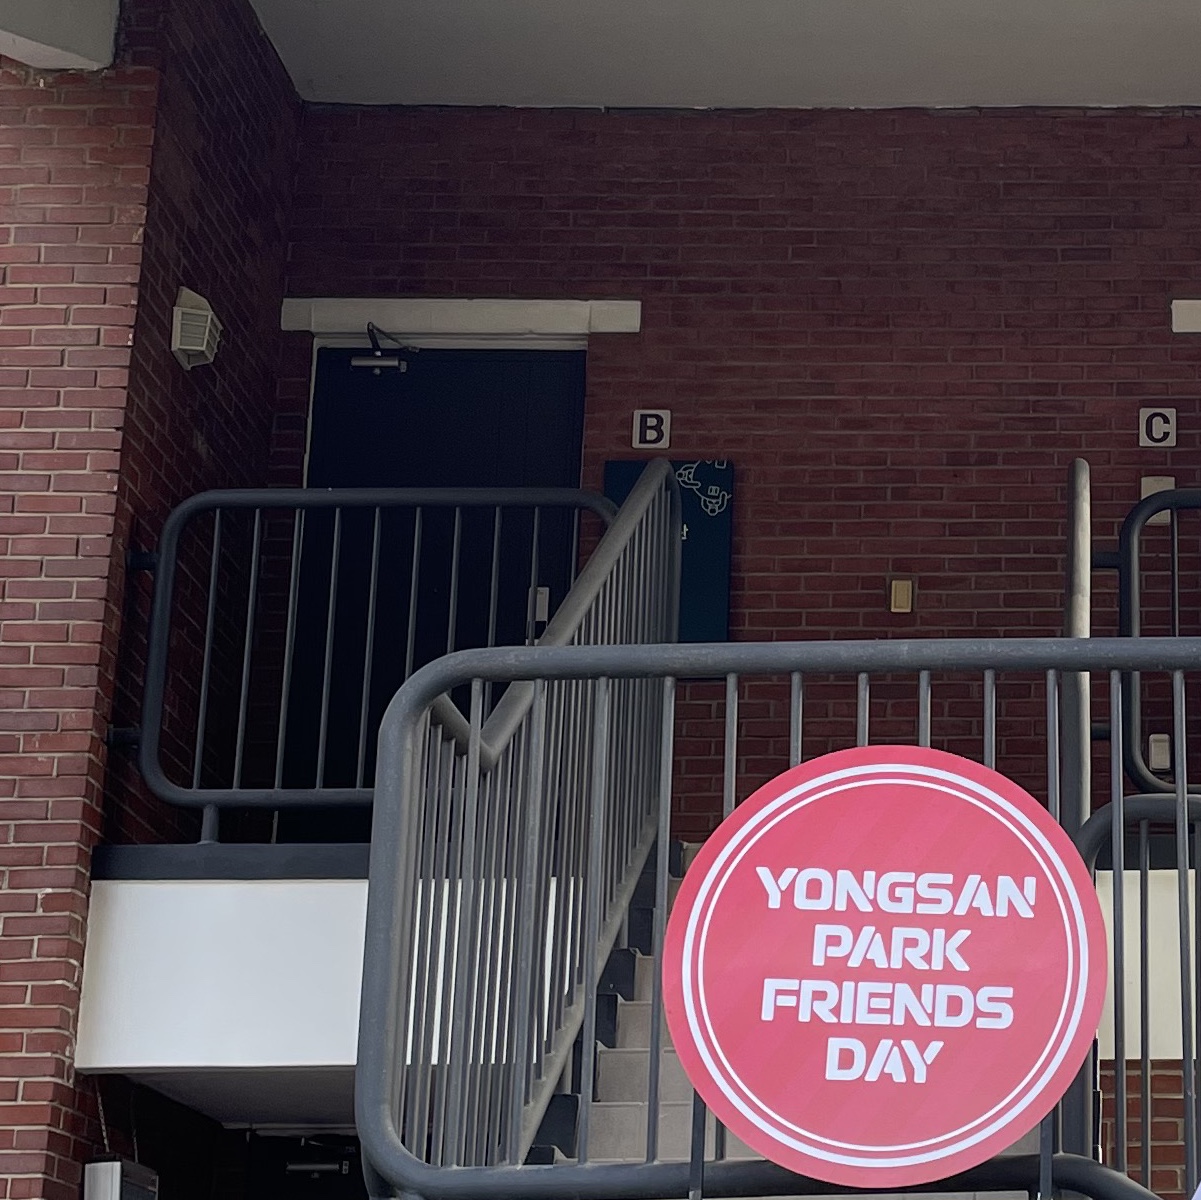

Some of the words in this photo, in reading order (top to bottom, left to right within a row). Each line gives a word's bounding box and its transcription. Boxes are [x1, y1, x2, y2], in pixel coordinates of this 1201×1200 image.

[638, 413, 665, 445] B
[1145, 411, 1171, 444] C
[756, 866, 1037, 919] YONGSAN
[812, 924, 972, 972] PARK
[761, 979, 1014, 1030] FRIENDS
[825, 1037, 945, 1084] DAY
